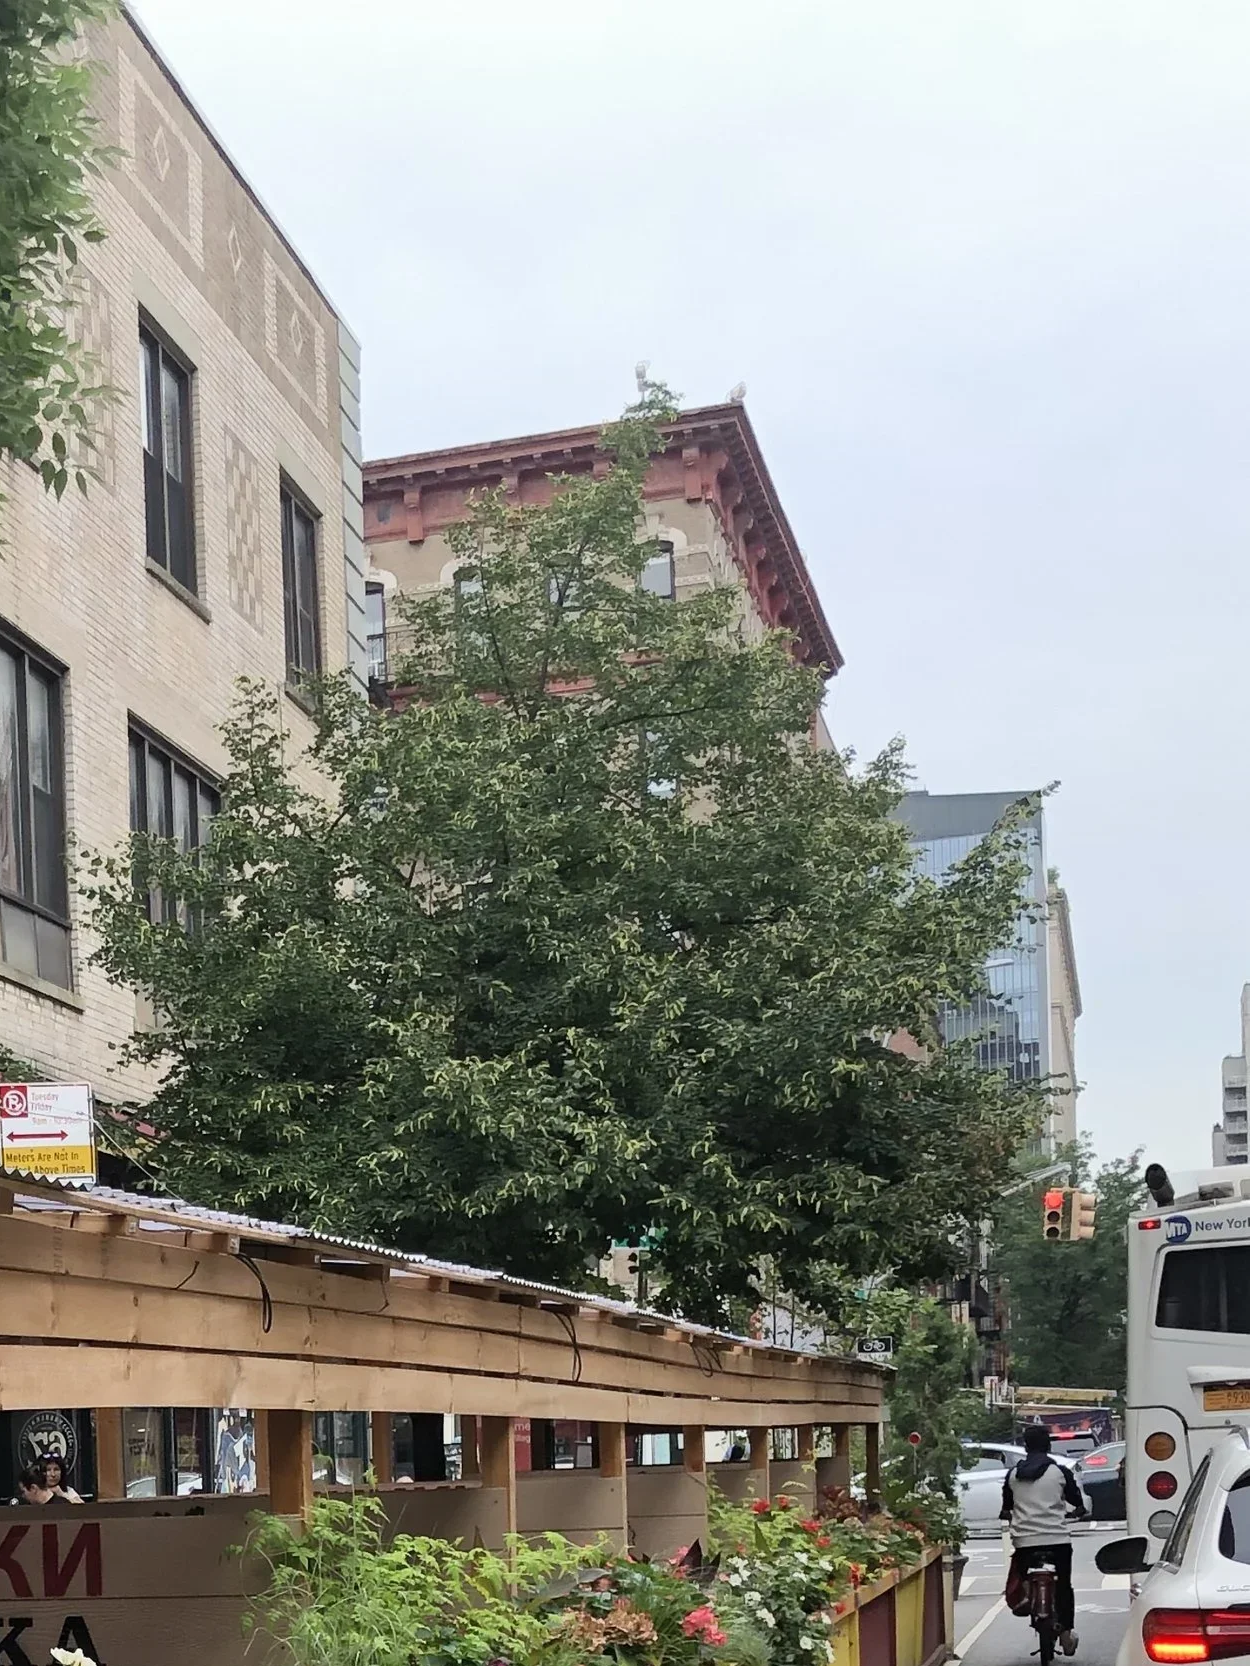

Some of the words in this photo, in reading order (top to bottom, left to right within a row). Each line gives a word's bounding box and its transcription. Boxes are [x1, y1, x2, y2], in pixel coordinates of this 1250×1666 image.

[6, 1153, 35, 1162] Meters
[37, 1153, 51, 1162] Are
[54, 1152, 68, 1161] Not
[71, 1151, 79, 1160] In
[34, 1165, 59, 1175] Above
[62, 1164, 86, 1174] Times
[1165, 1220, 1188, 1239] MTA
[1195, 1221, 1224, 1231] New
[1226, 1217, 1250, 1229] Yor
